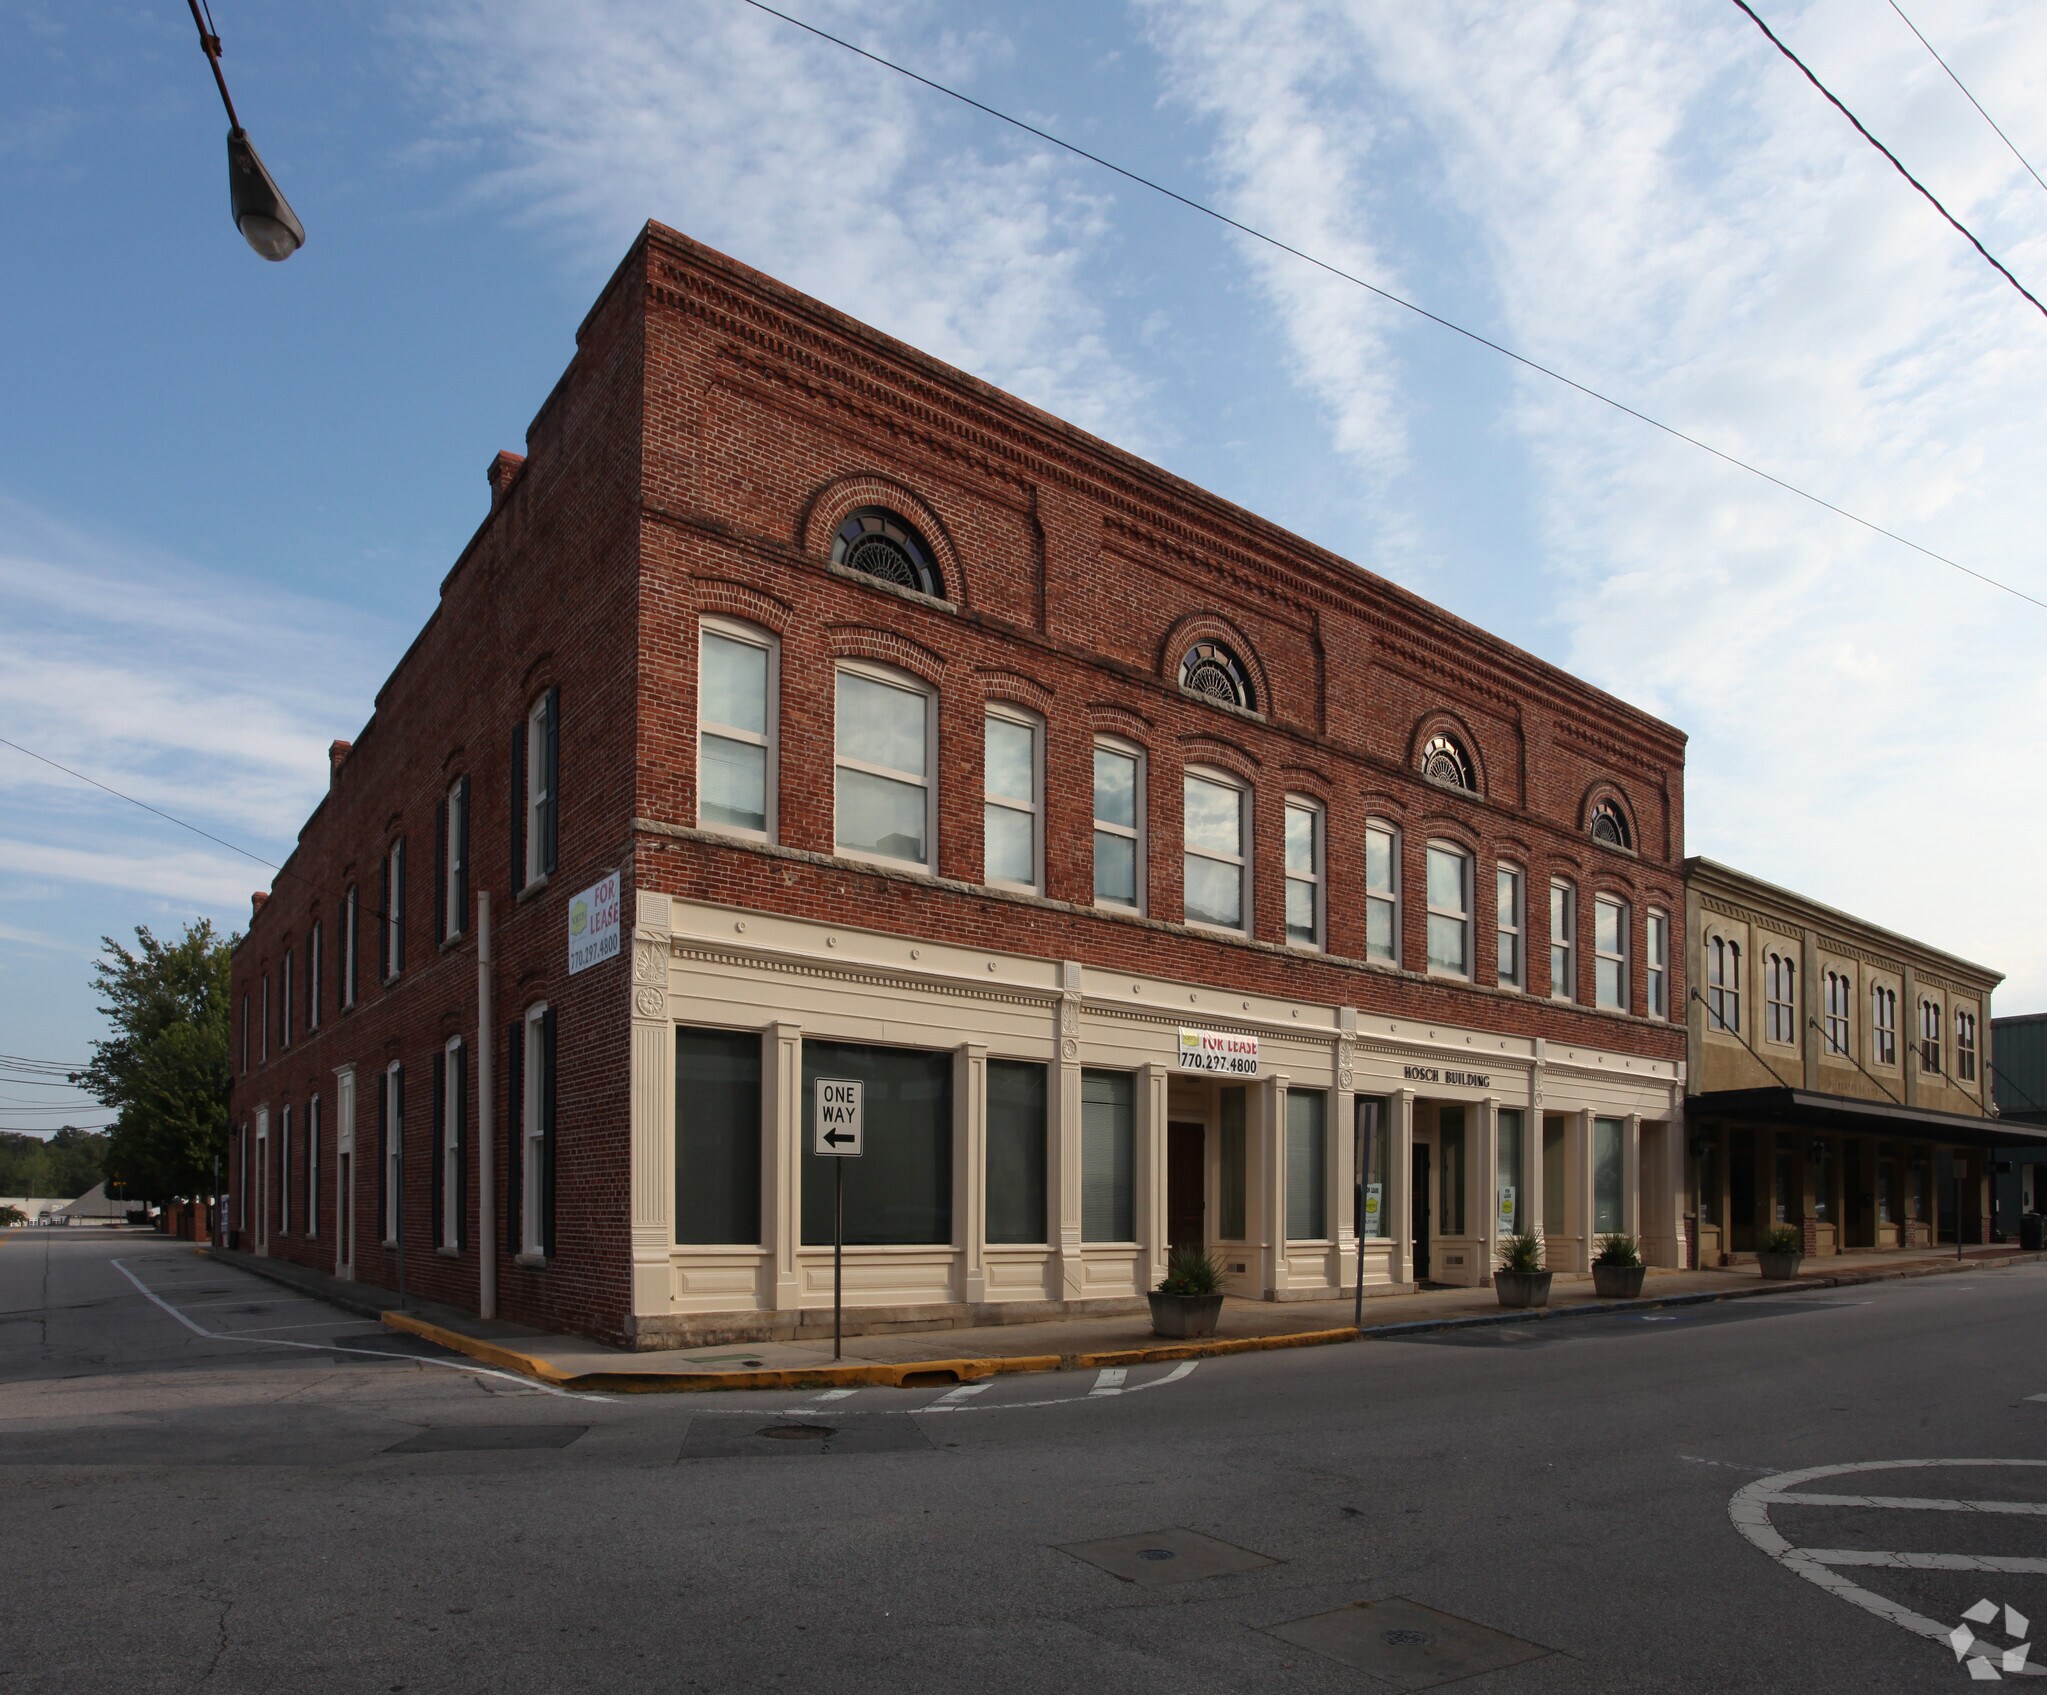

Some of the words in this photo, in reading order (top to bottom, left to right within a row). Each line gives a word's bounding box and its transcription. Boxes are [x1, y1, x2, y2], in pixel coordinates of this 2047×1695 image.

[594, 879, 615, 907] FOR
[590, 902, 619, 935] LEASE
[570, 933, 618, 971] 770.297.4800
[1202, 1035, 1225, 1052] FOR
[1228, 1039, 1257, 1055] LEASE
[1181, 1052, 1257, 1074] 770.297.4800
[1404, 1066, 1439, 1082] HOSCH
[1445, 1071, 1490, 1088] BUILDING
[824, 1086, 854, 1103] ONE
[823, 1106, 855, 1123] WAY
